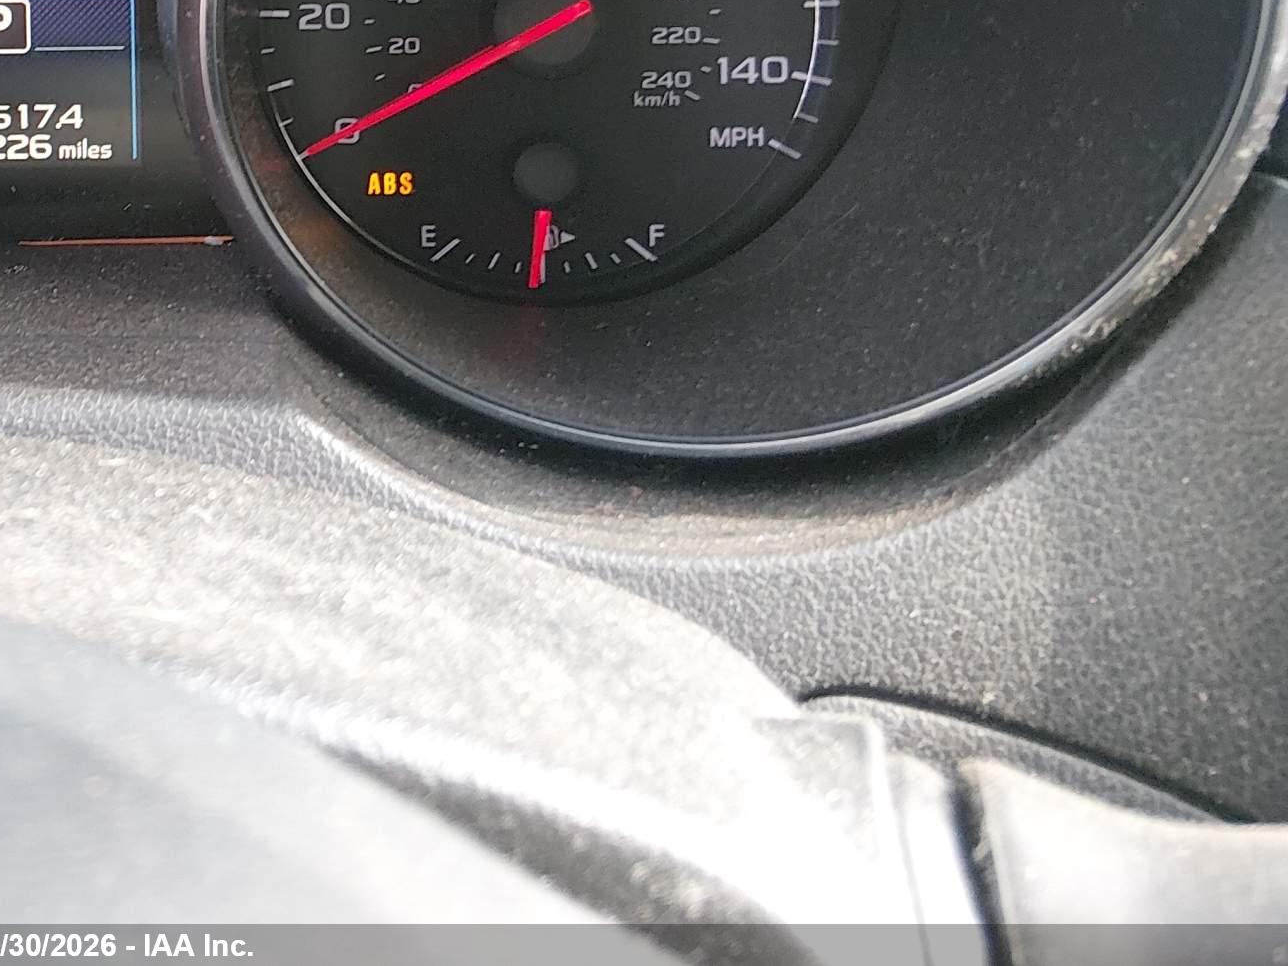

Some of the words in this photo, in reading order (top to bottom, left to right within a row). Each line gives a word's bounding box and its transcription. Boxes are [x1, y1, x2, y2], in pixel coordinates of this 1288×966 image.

[299, 3, 349, 29] 20
[389, 38, 420, 53] 20
[653, 27, 701, 44] 220
[641, 71, 691, 89] 240
[717, 57, 788, 84] 140
[633, 91, 681, 107] km/h
[710, 127, 764, 147] MPH
[59, 138, 112, 159] miles
[368, 172, 412, 194] ABS
[421, 225, 436, 247] E
[650, 225, 665, 247] F
